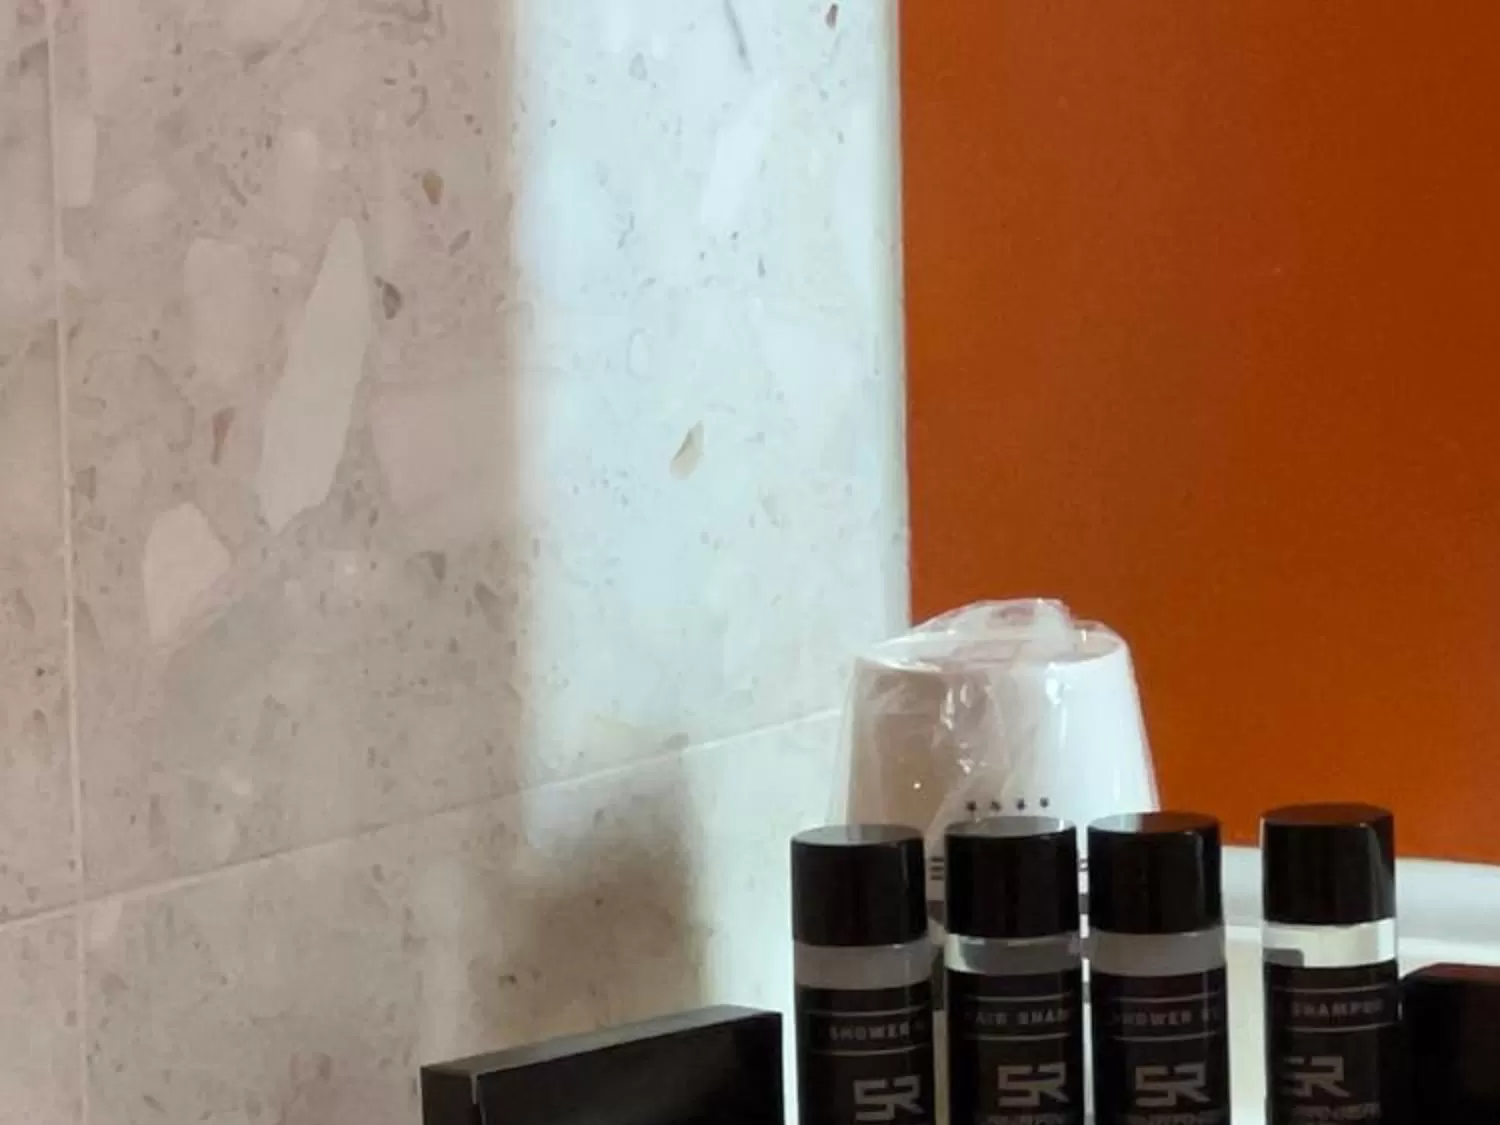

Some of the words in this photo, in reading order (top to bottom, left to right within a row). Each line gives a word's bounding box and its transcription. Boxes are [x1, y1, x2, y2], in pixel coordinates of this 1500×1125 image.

[851, 1074, 926, 1121] SR
[997, 1061, 1070, 1107] SR
[1135, 1061, 1211, 1107] SR
